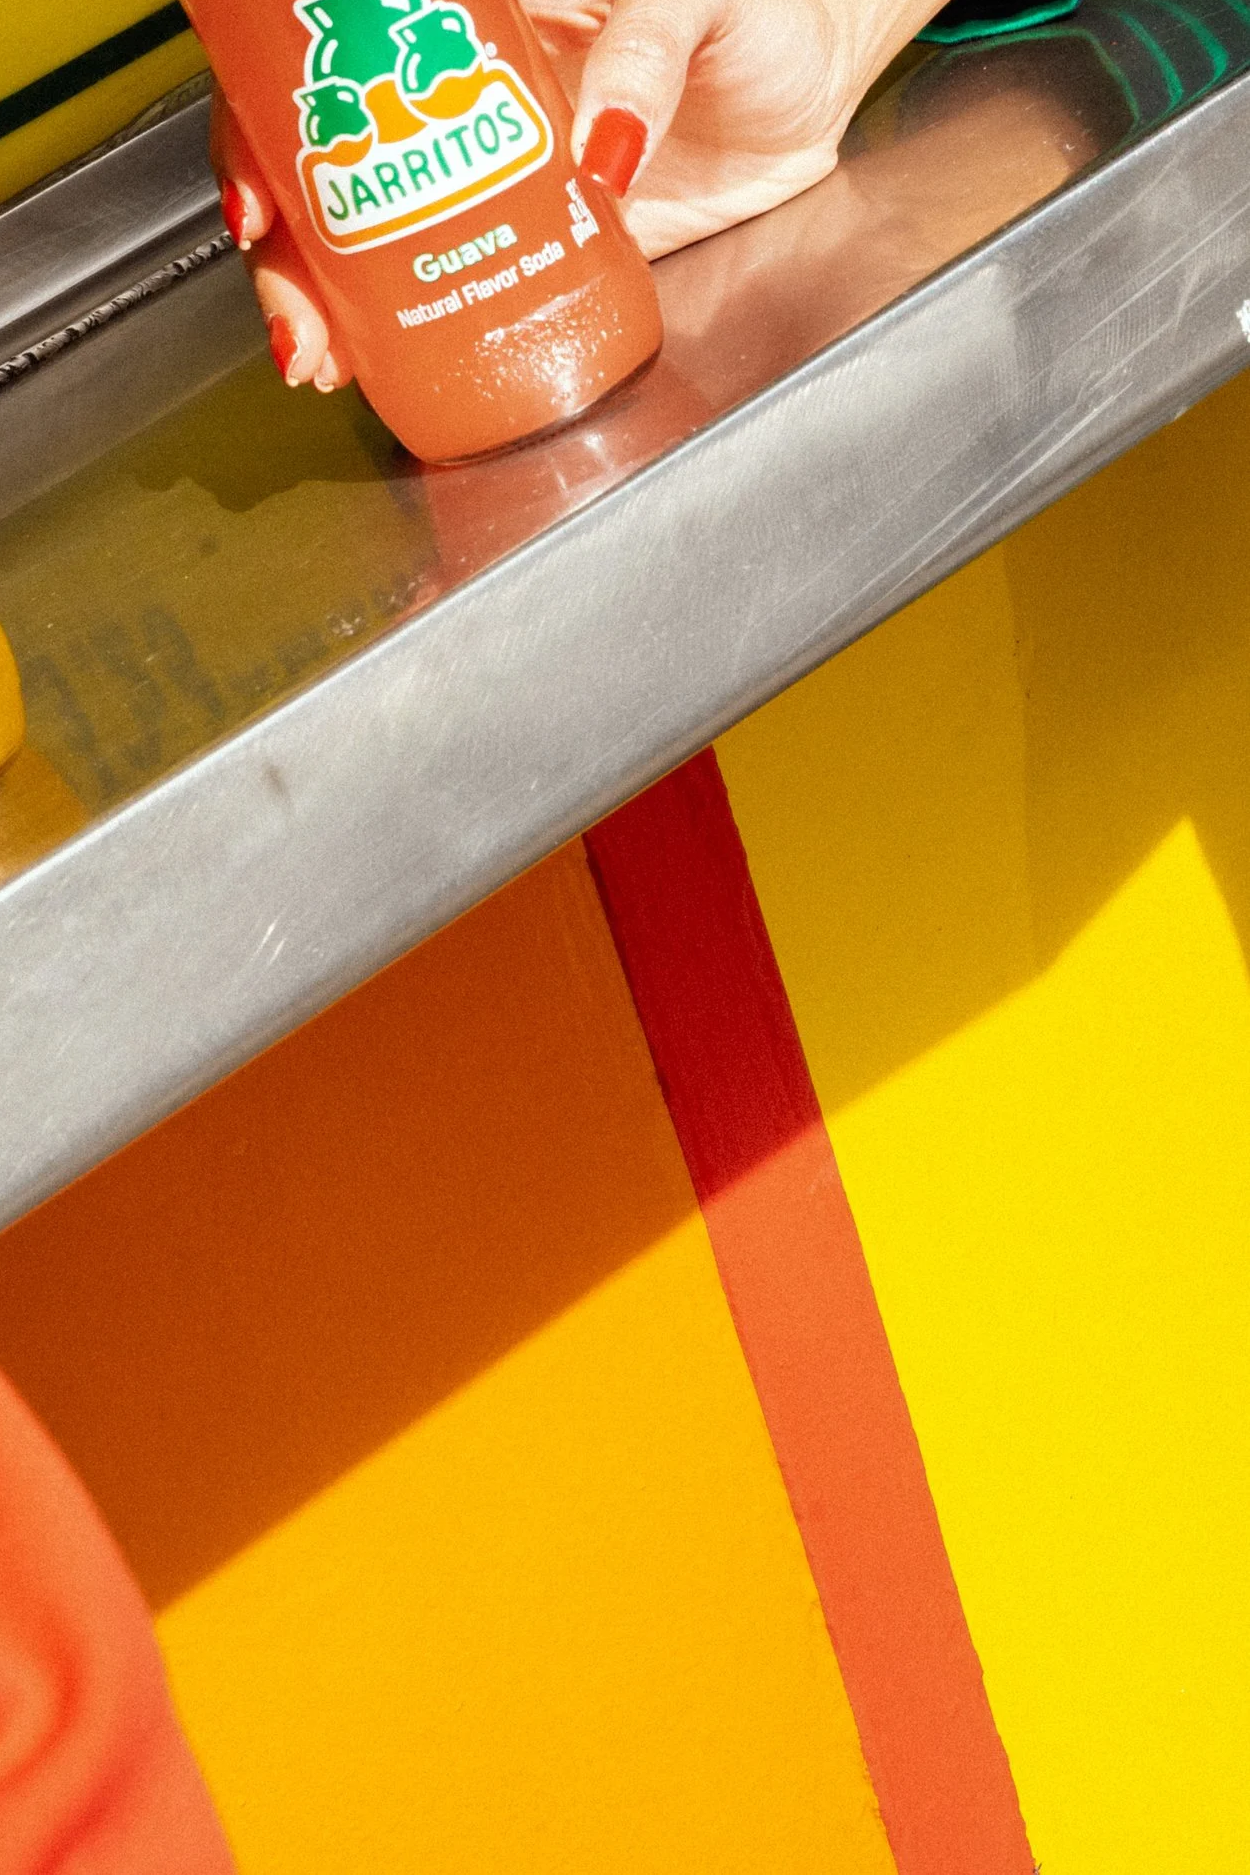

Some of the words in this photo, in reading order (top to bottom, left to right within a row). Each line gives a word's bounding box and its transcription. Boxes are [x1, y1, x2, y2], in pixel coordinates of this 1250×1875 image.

[325, 99, 526, 222] JARRITOS
[395, 288, 463, 329] Natural
[460, 265, 520, 306] Flavor
[518, 240, 566, 278] Soda
[412, 223, 518, 283] Guava
